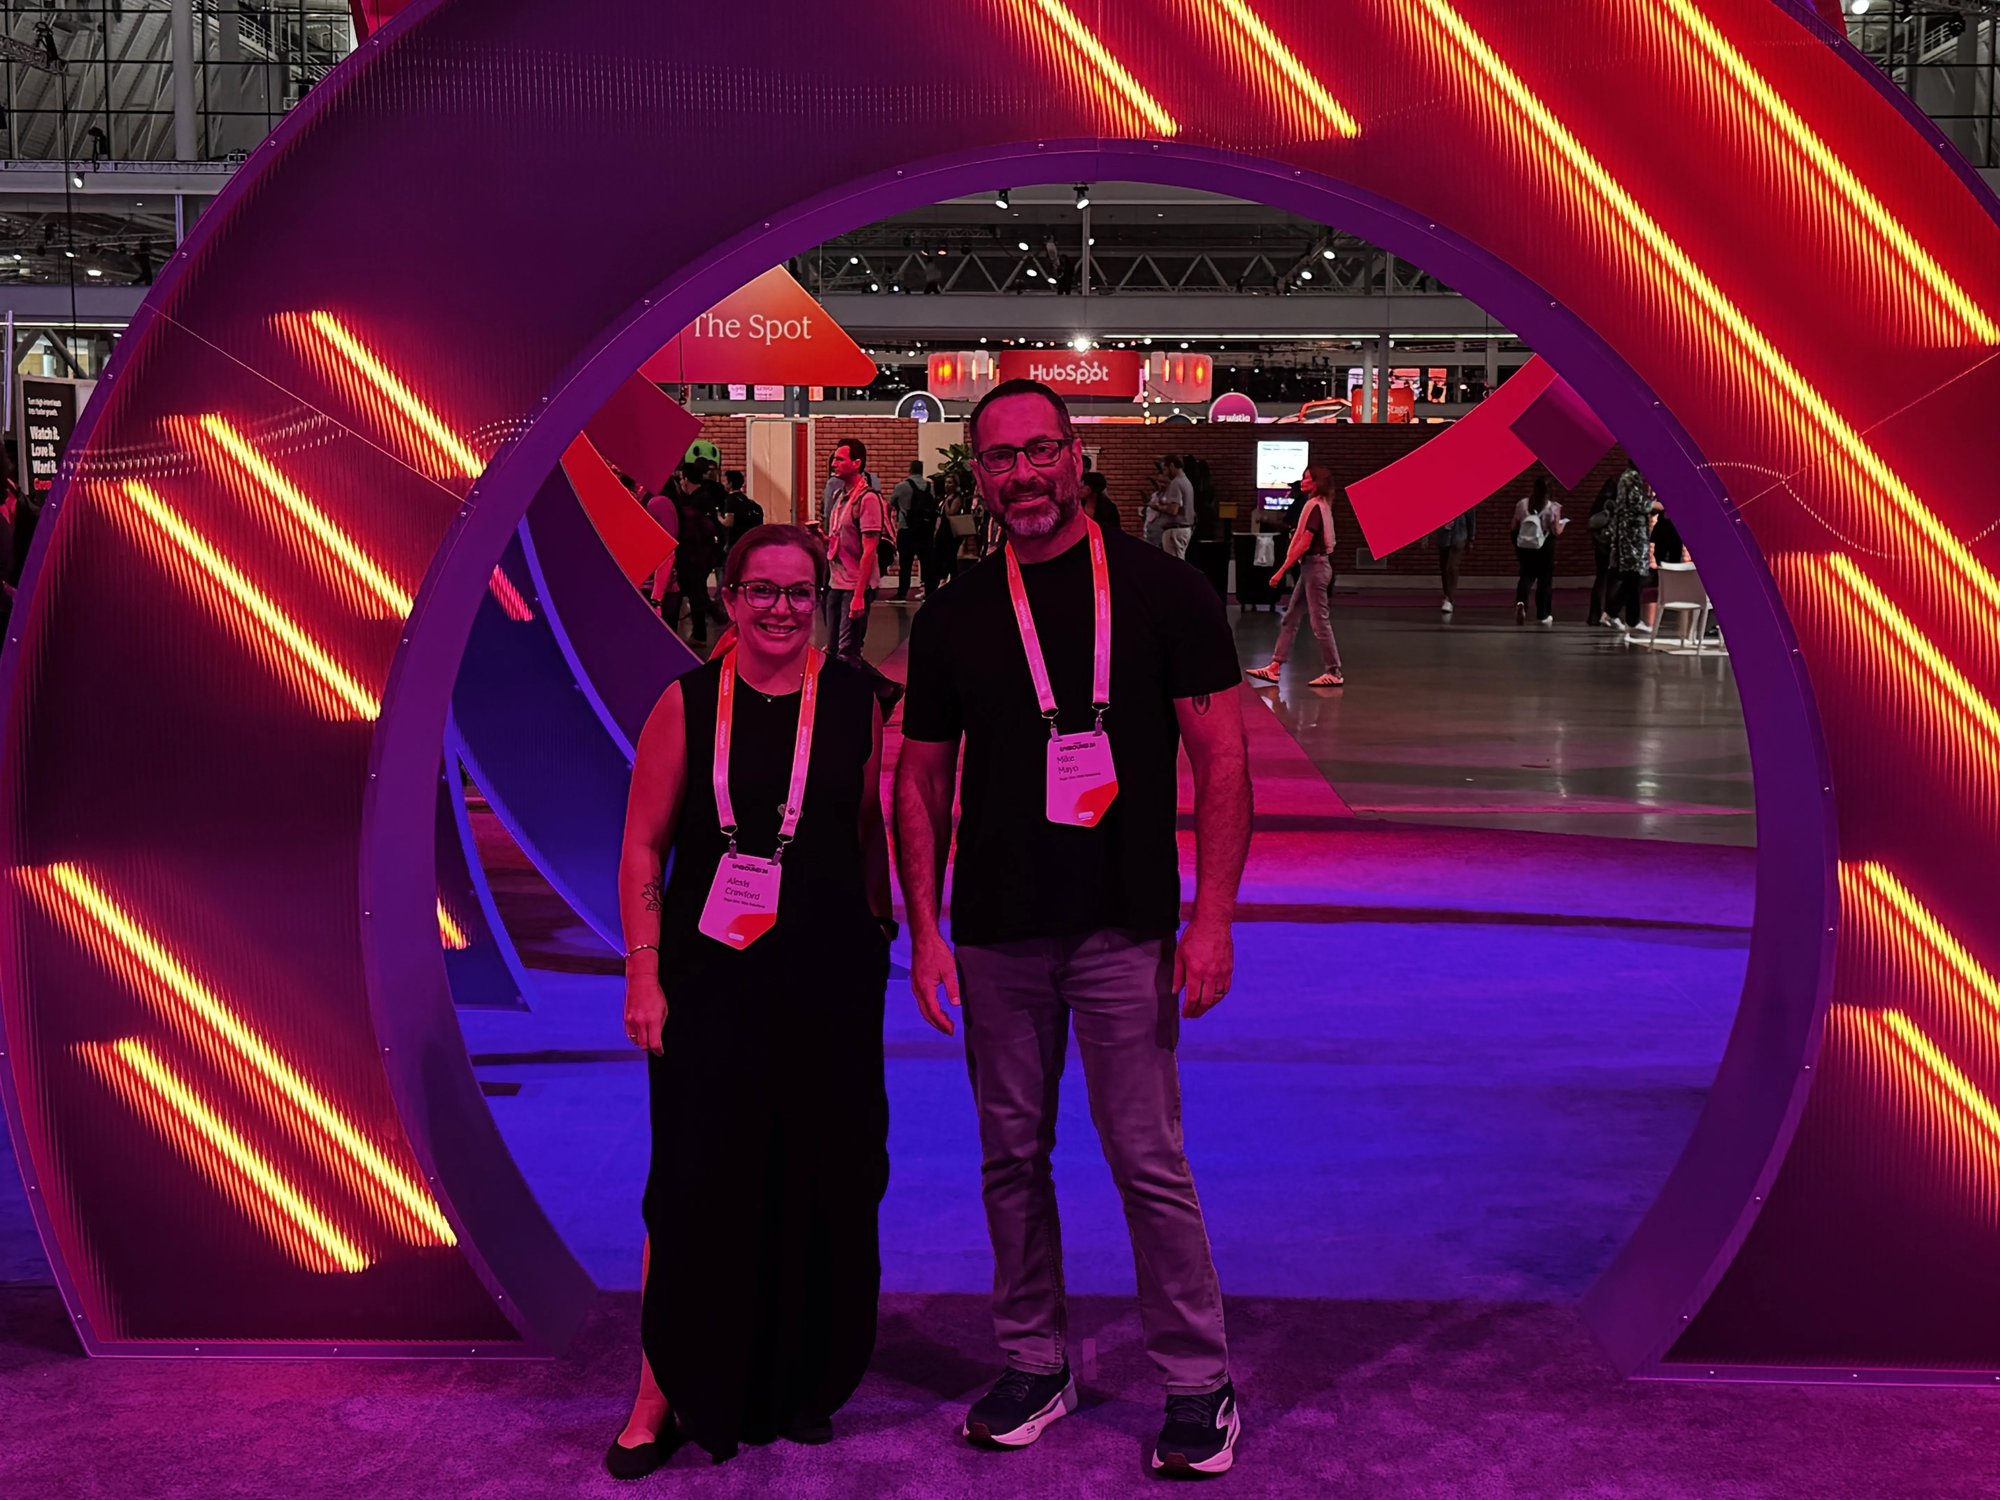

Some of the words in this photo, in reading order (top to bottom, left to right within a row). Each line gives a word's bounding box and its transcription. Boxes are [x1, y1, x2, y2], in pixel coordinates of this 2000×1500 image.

[694, 313, 741, 338] The
[749, 314, 812, 346] Spot
[1029, 360, 1109, 385] HubSpot
[29, 425, 52, 440] Watch
[52, 425, 60, 441] it.
[31, 442, 48, 457] Love
[48, 442, 56, 457] it.
[32, 459, 51, 474] Want
[1057, 756, 1075, 764] Mike
[1058, 766, 1079, 774] Mayo
[727, 877, 750, 888] Alexis
[725, 887, 760, 900] Crawford
